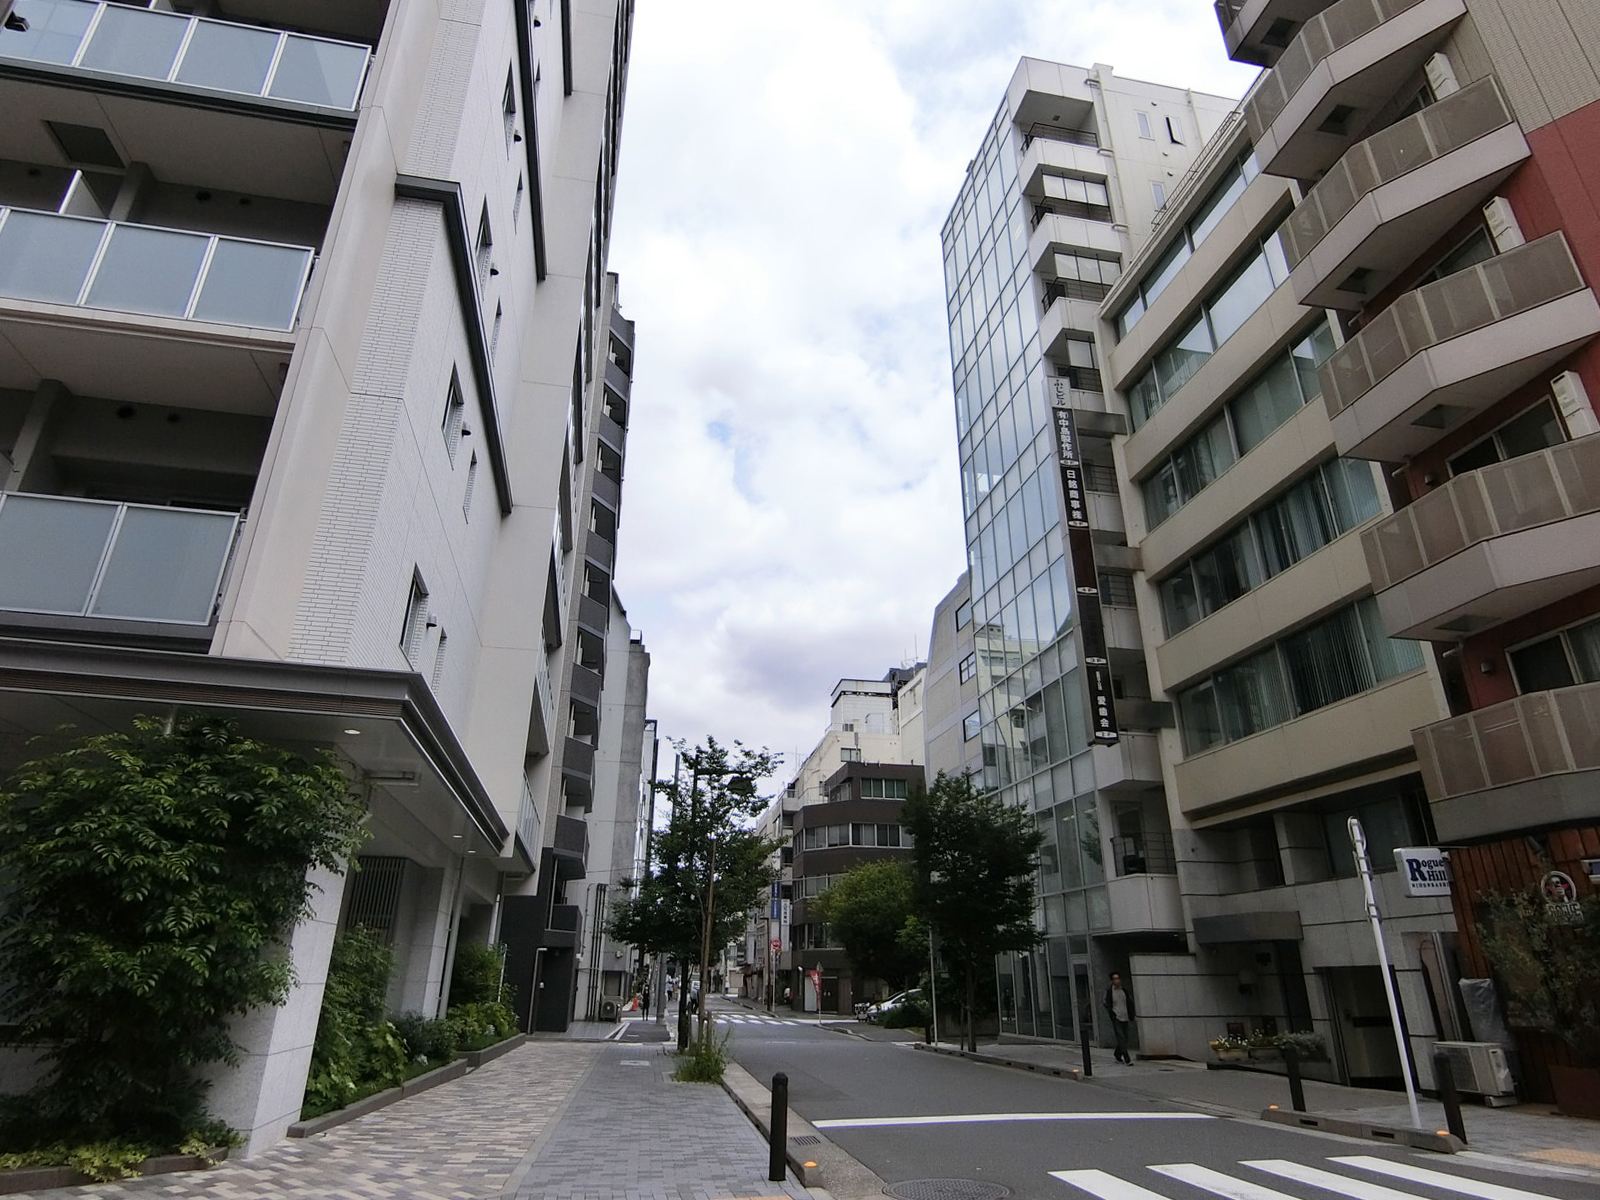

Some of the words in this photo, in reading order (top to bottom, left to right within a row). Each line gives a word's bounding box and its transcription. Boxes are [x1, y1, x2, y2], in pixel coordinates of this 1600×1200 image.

[1054, 379, 1066, 406] ふじビル
[1406, 858, 1444, 881] Rogue
[1426, 870, 1447, 881] Hill
